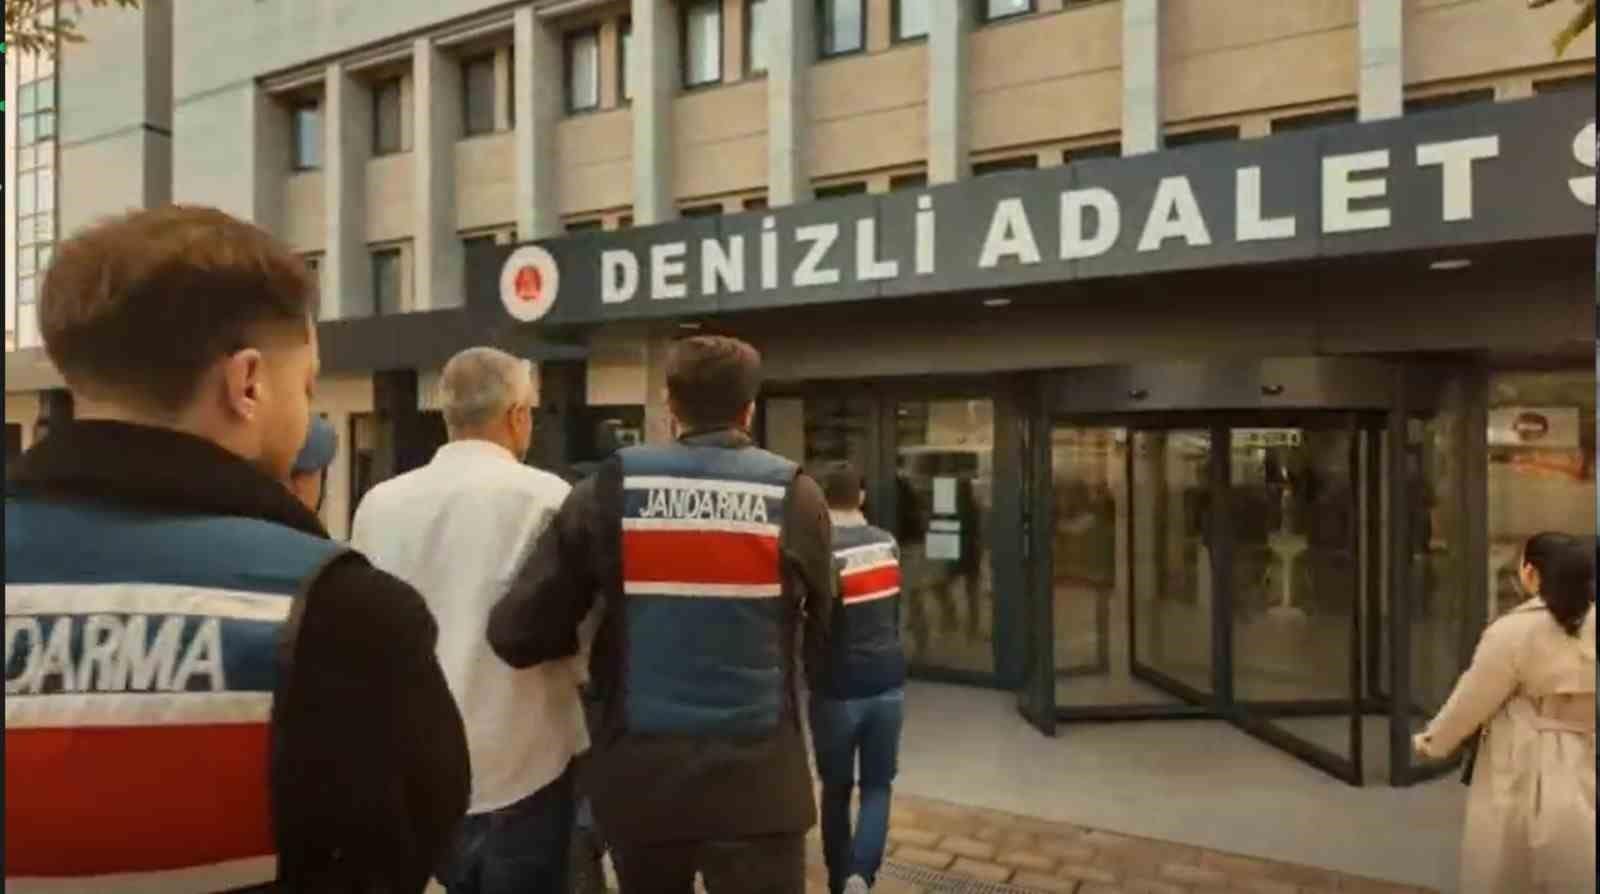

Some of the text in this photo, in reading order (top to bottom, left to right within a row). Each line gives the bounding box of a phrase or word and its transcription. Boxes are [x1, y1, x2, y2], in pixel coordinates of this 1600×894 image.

[601, 195, 935, 304] DENİZLİ
[978, 135, 1499, 267] ADALET
[640, 487, 768, 523] JANDARMA
